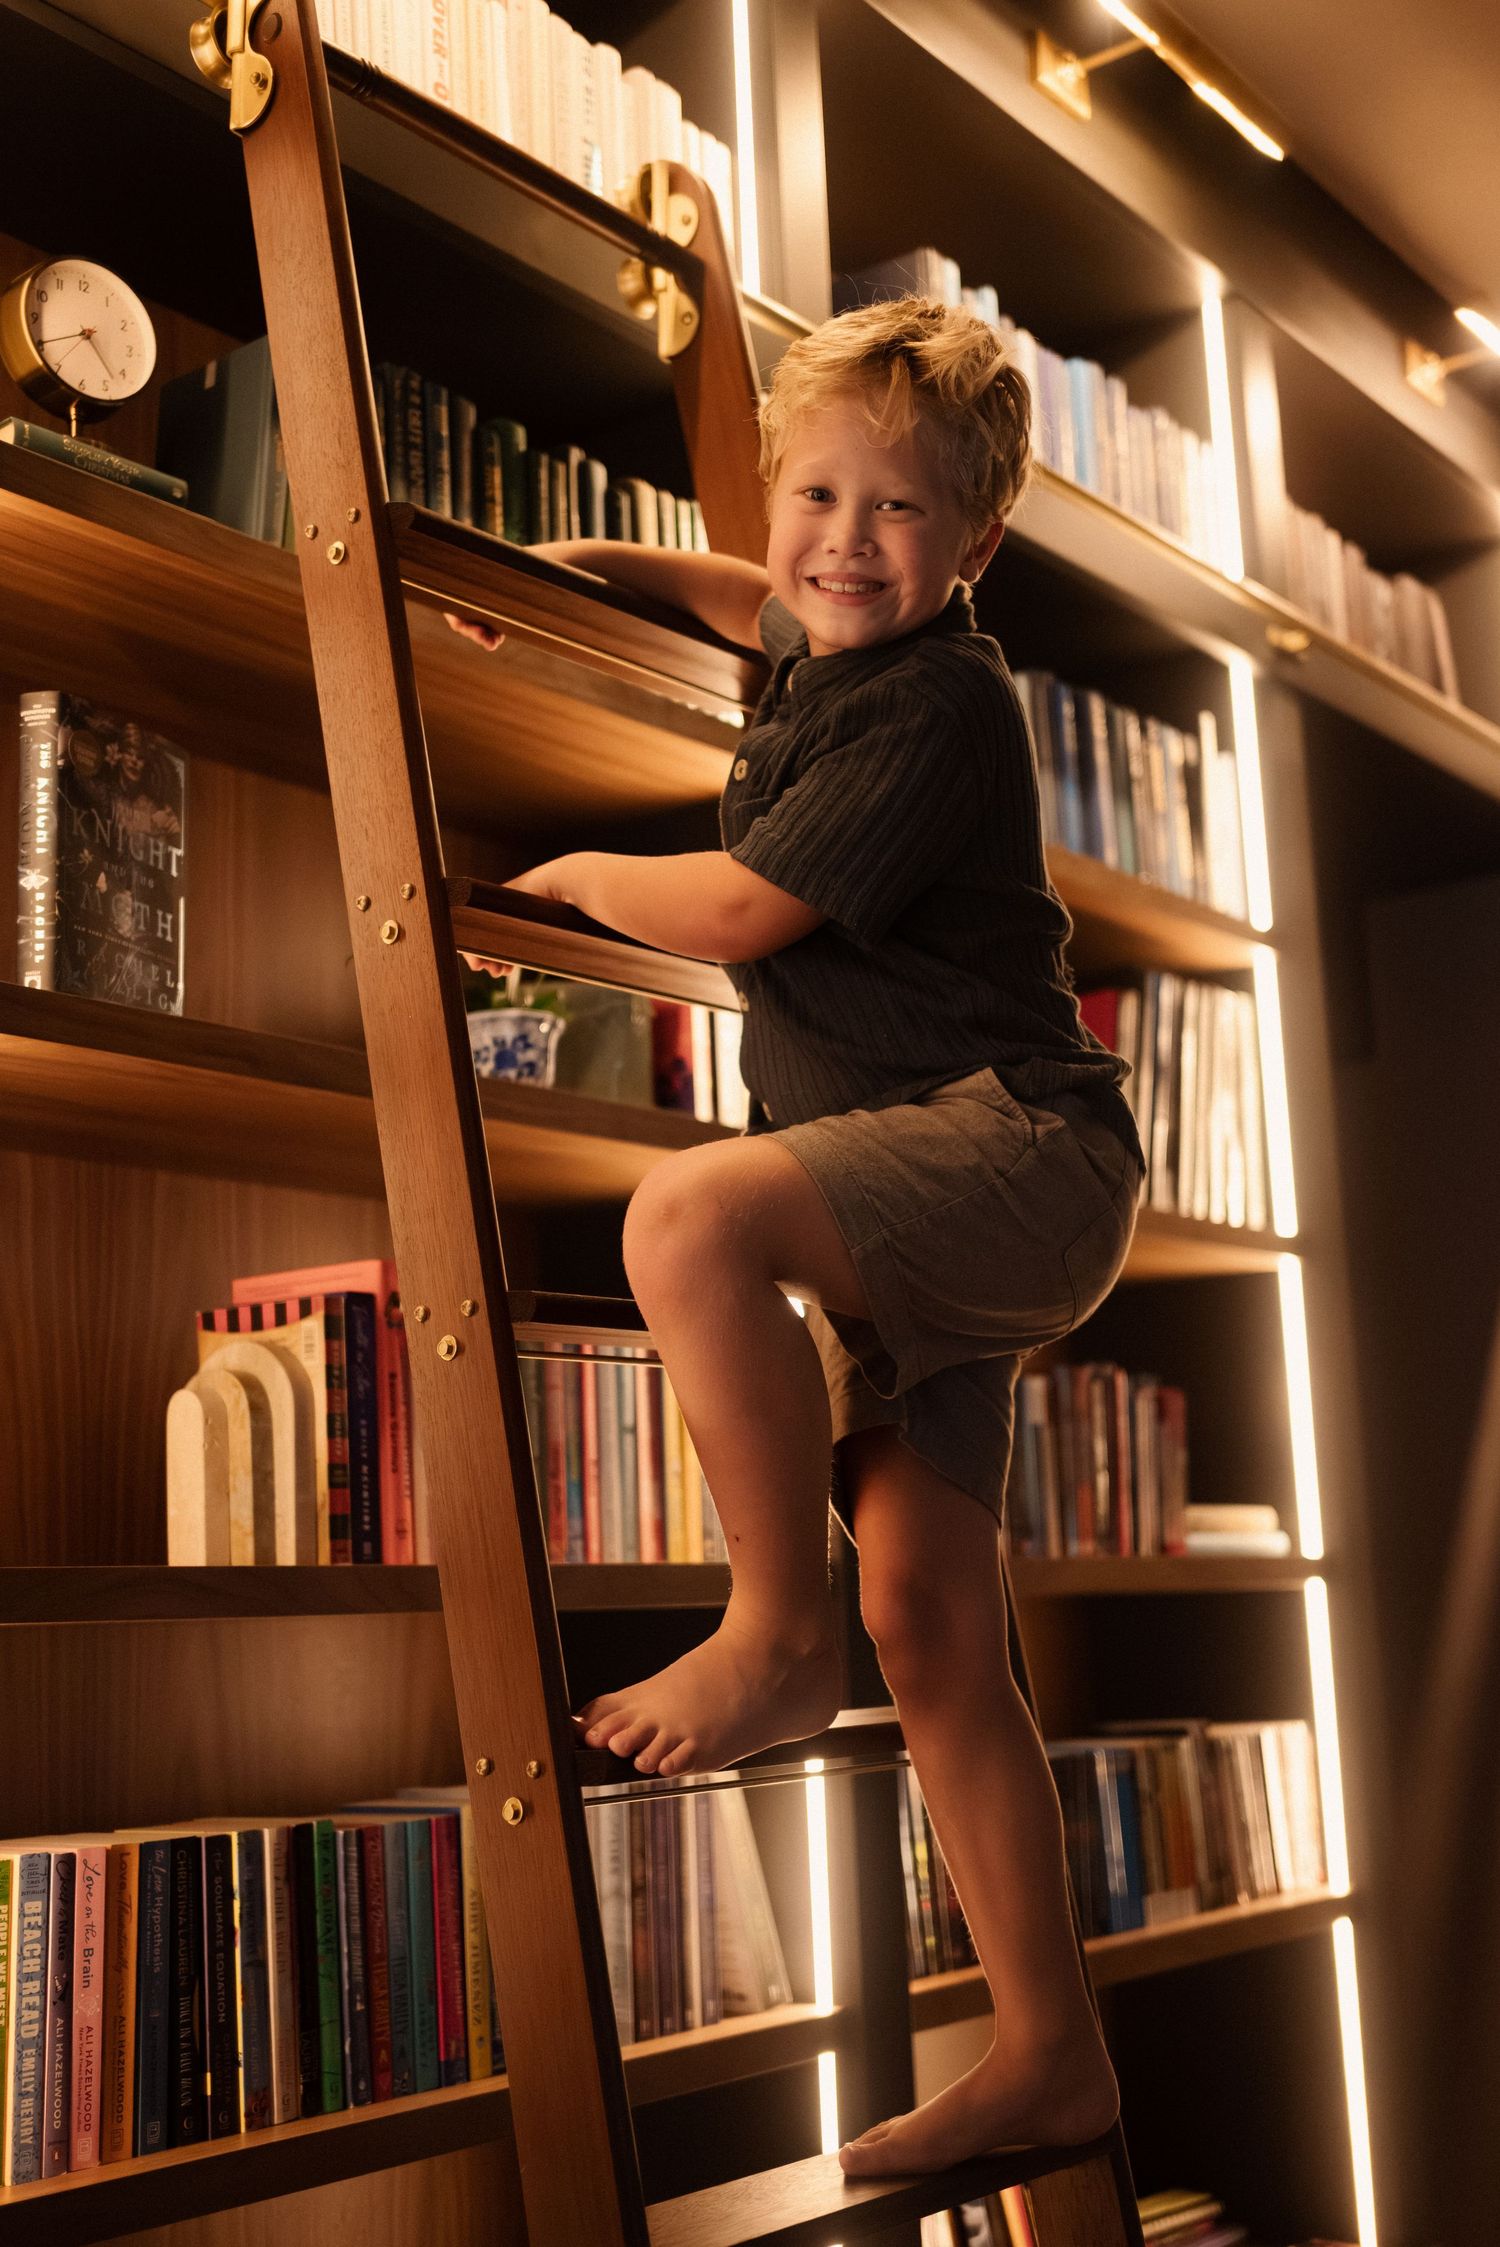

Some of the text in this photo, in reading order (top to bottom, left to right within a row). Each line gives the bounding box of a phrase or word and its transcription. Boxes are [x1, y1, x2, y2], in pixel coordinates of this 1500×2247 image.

[31, 312, 39, 325] 9
[36, 290, 48, 303] 10
[56, 278, 63, 291] 11
[79, 279, 90, 293] 12
[120, 319, 127, 332] 2
[126, 345, 133, 358] 3
[78, 379, 86, 391] 6
[102, 380, 109, 392] 5
[72, 807, 184, 879] KNIGHT
[22, 1901, 42, 1974] BEACH
[56, 1919, 69, 1961] Mate
[82, 1858, 101, 1989] Love on the Brain
[149, 1896, 164, 1974] Hypothesis
[176, 1850, 189, 1987] CHRISTINA LAUREN
[214, 1875, 225, 1948] SOULMATE
[20, 1980, 41, 2039] READ
[216, 1951, 227, 2024] EQUATION
[19, 2048, 37, 2145] EMILY HENRY
[53, 2017, 65, 2129] ALI HAZELWOOD
[83, 2025, 94, 2133] ALI HAZELWOOD
[116, 2014, 126, 2124] ALI HAZELWOOD
